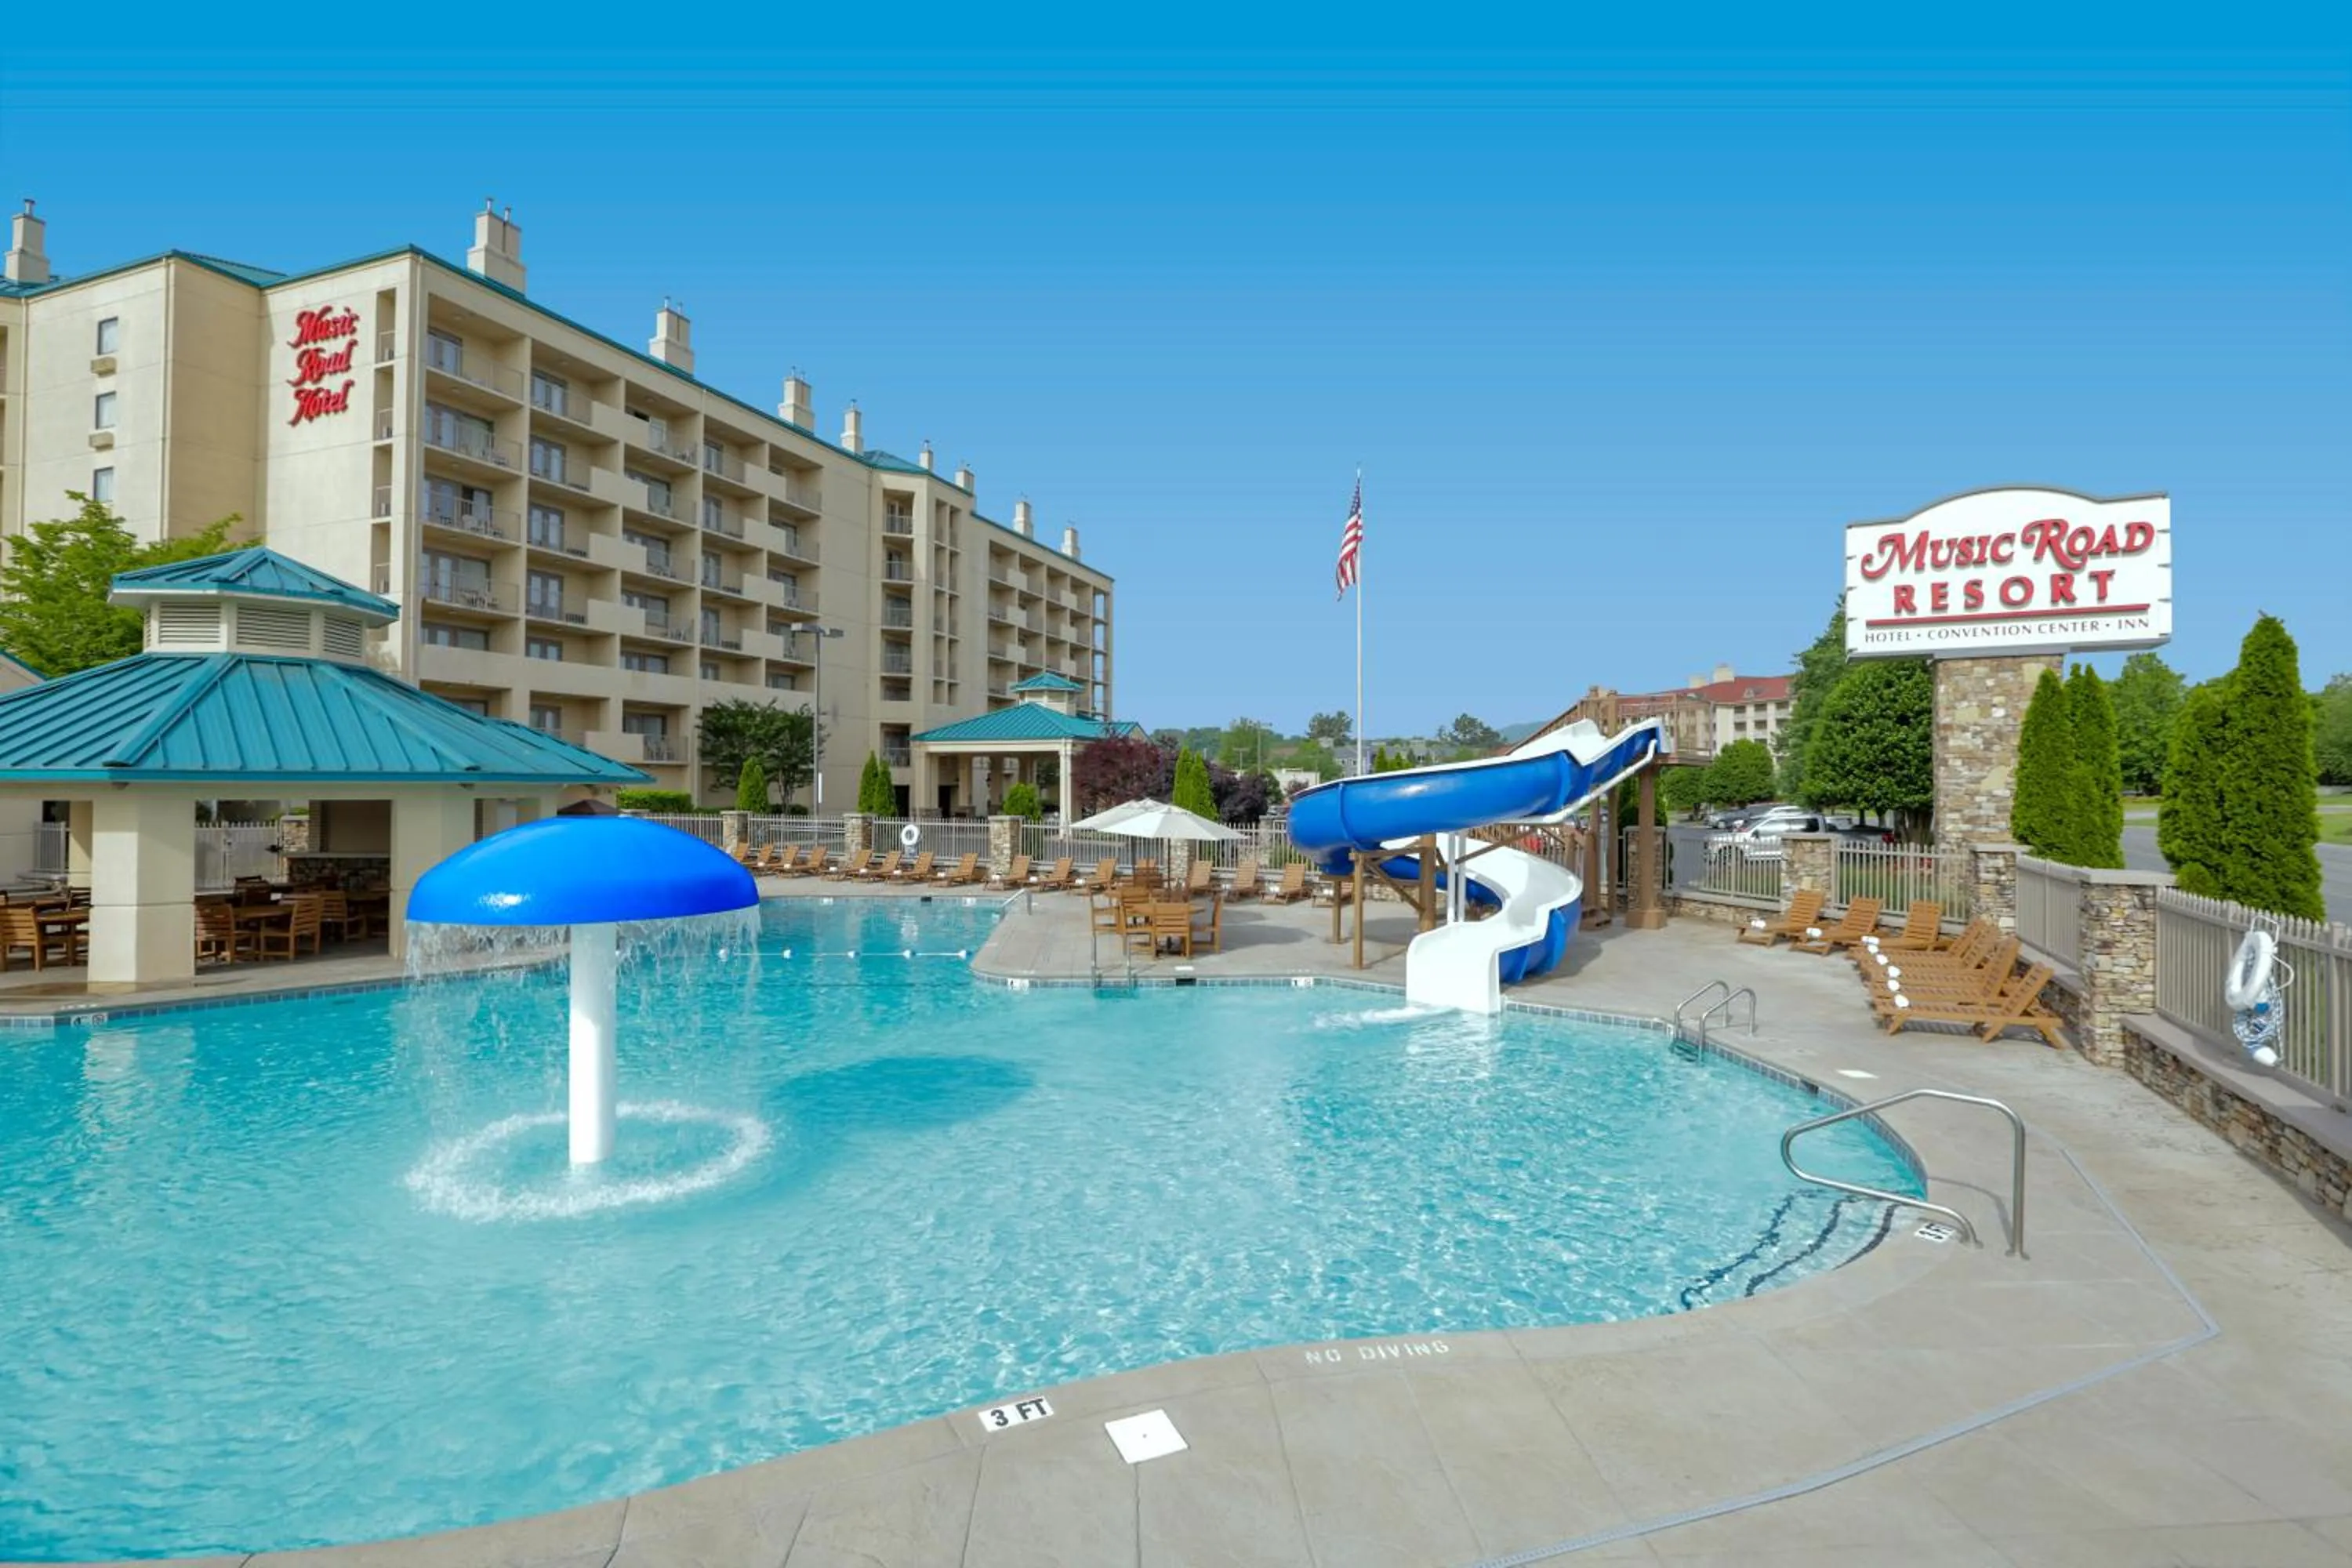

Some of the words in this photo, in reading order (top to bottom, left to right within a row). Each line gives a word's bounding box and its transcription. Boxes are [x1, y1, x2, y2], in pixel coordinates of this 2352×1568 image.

[286, 305, 360, 348] Music
[286, 339, 358, 387] Road
[287, 379, 355, 427] Hotel
[1861, 530, 2016, 579] MUSIC
[2021, 518, 2155, 571] ROAD
[1893, 569, 2115, 614] RESORT
[1865, 631, 1912, 643] HOTEL
[1927, 625, 2031, 640] CONVENTION
[2038, 620, 2100, 634] CENTER
[2118, 618, 2149, 630] INN
[1305, 1348, 1342, 1364] NO
[1358, 1340, 1450, 1360] DIVING
[990, 1409, 1009, 1426] 3
[1015, 1398, 1047, 1420] FT
